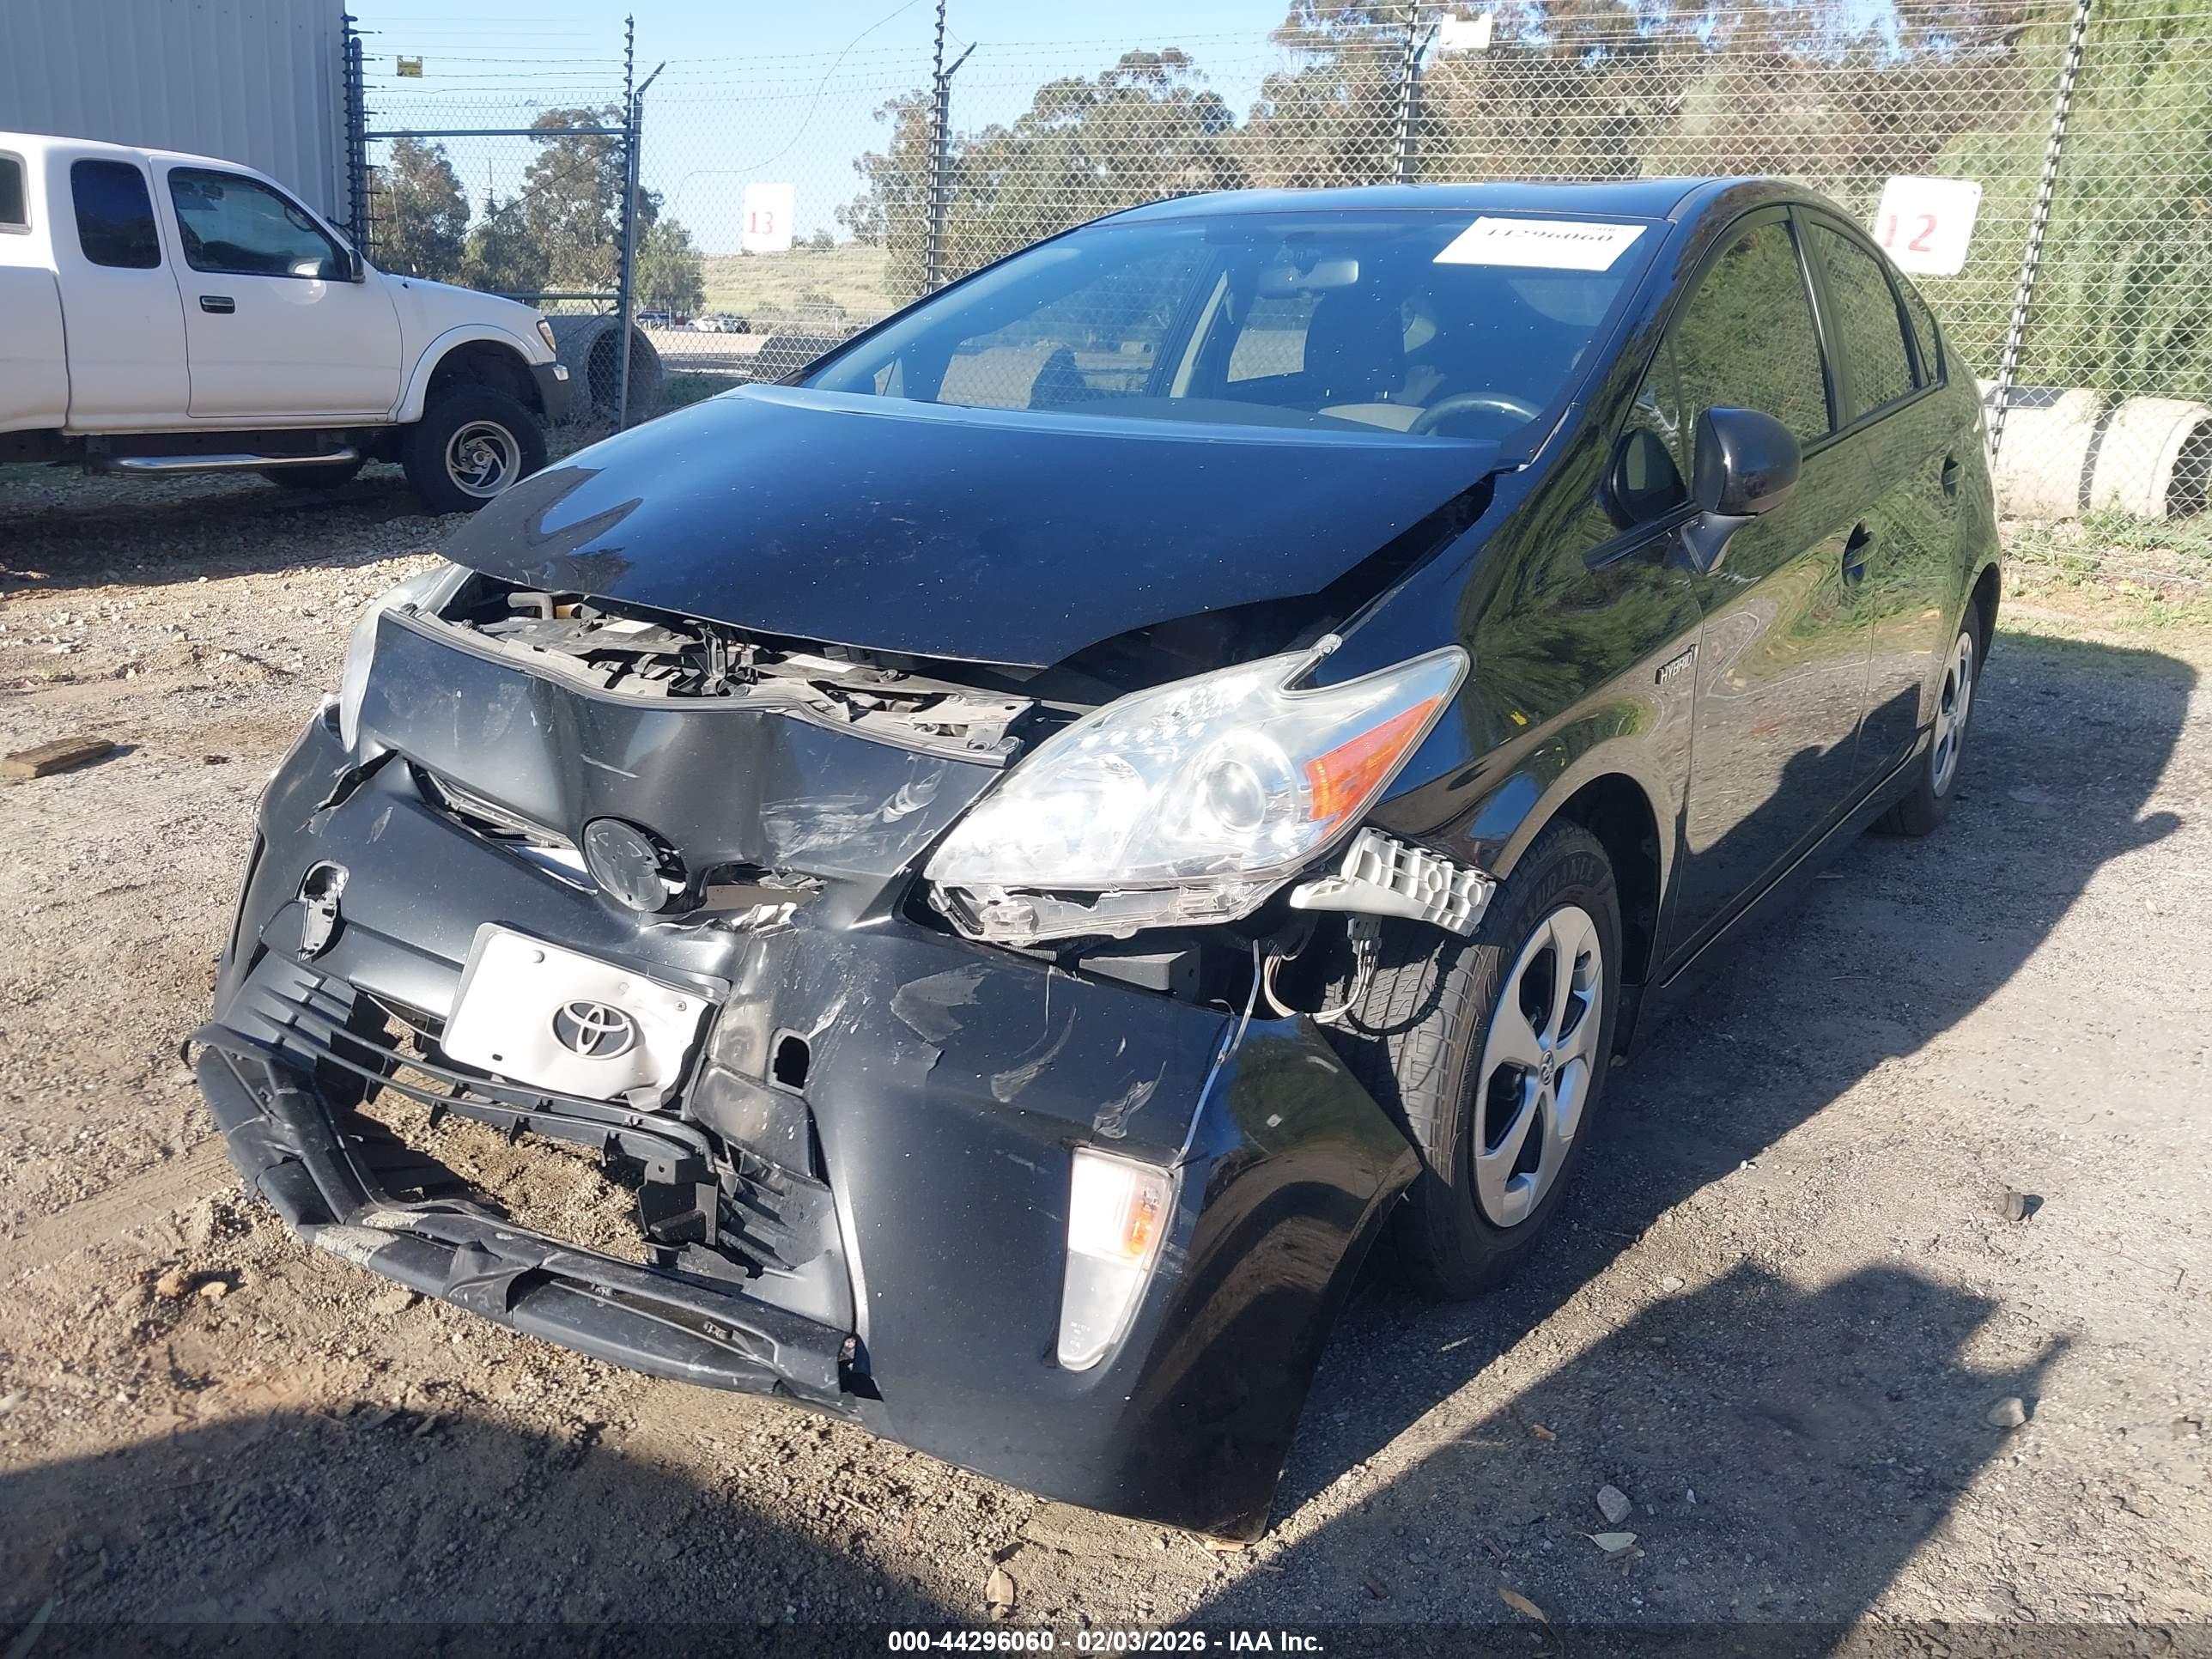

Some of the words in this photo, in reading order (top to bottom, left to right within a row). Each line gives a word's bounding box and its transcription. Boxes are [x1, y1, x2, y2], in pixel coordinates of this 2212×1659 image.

[749, 211, 774, 234] 13
[1884, 215, 1937, 252] 12
[1661, 652, 1692, 684] HYBRID
